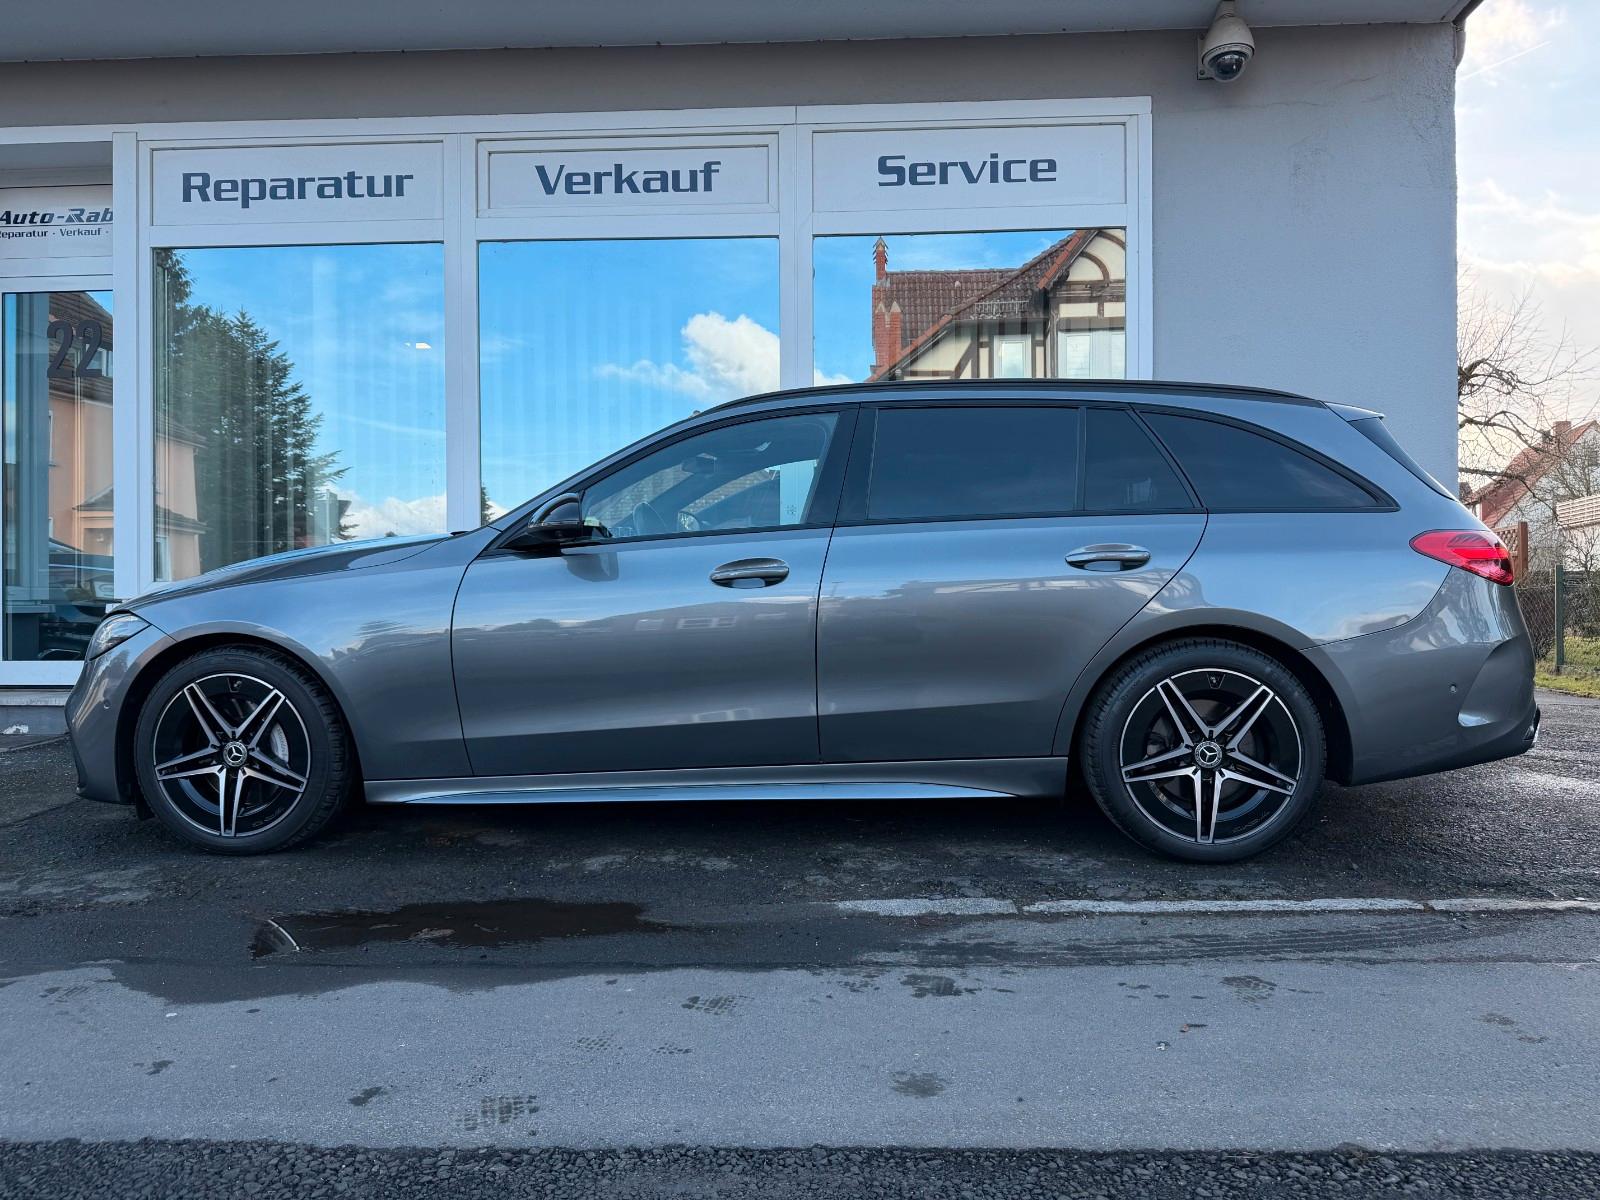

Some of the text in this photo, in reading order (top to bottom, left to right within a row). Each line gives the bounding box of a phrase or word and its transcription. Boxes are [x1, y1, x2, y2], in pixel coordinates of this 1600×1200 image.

[534, 160, 722, 195] Verkauf
[877, 152, 1057, 187] Service
[182, 170, 414, 209] Reparatur
[0, 227, 102, 239] eparatur Verkauf
[46, 319, 103, 378] 22
